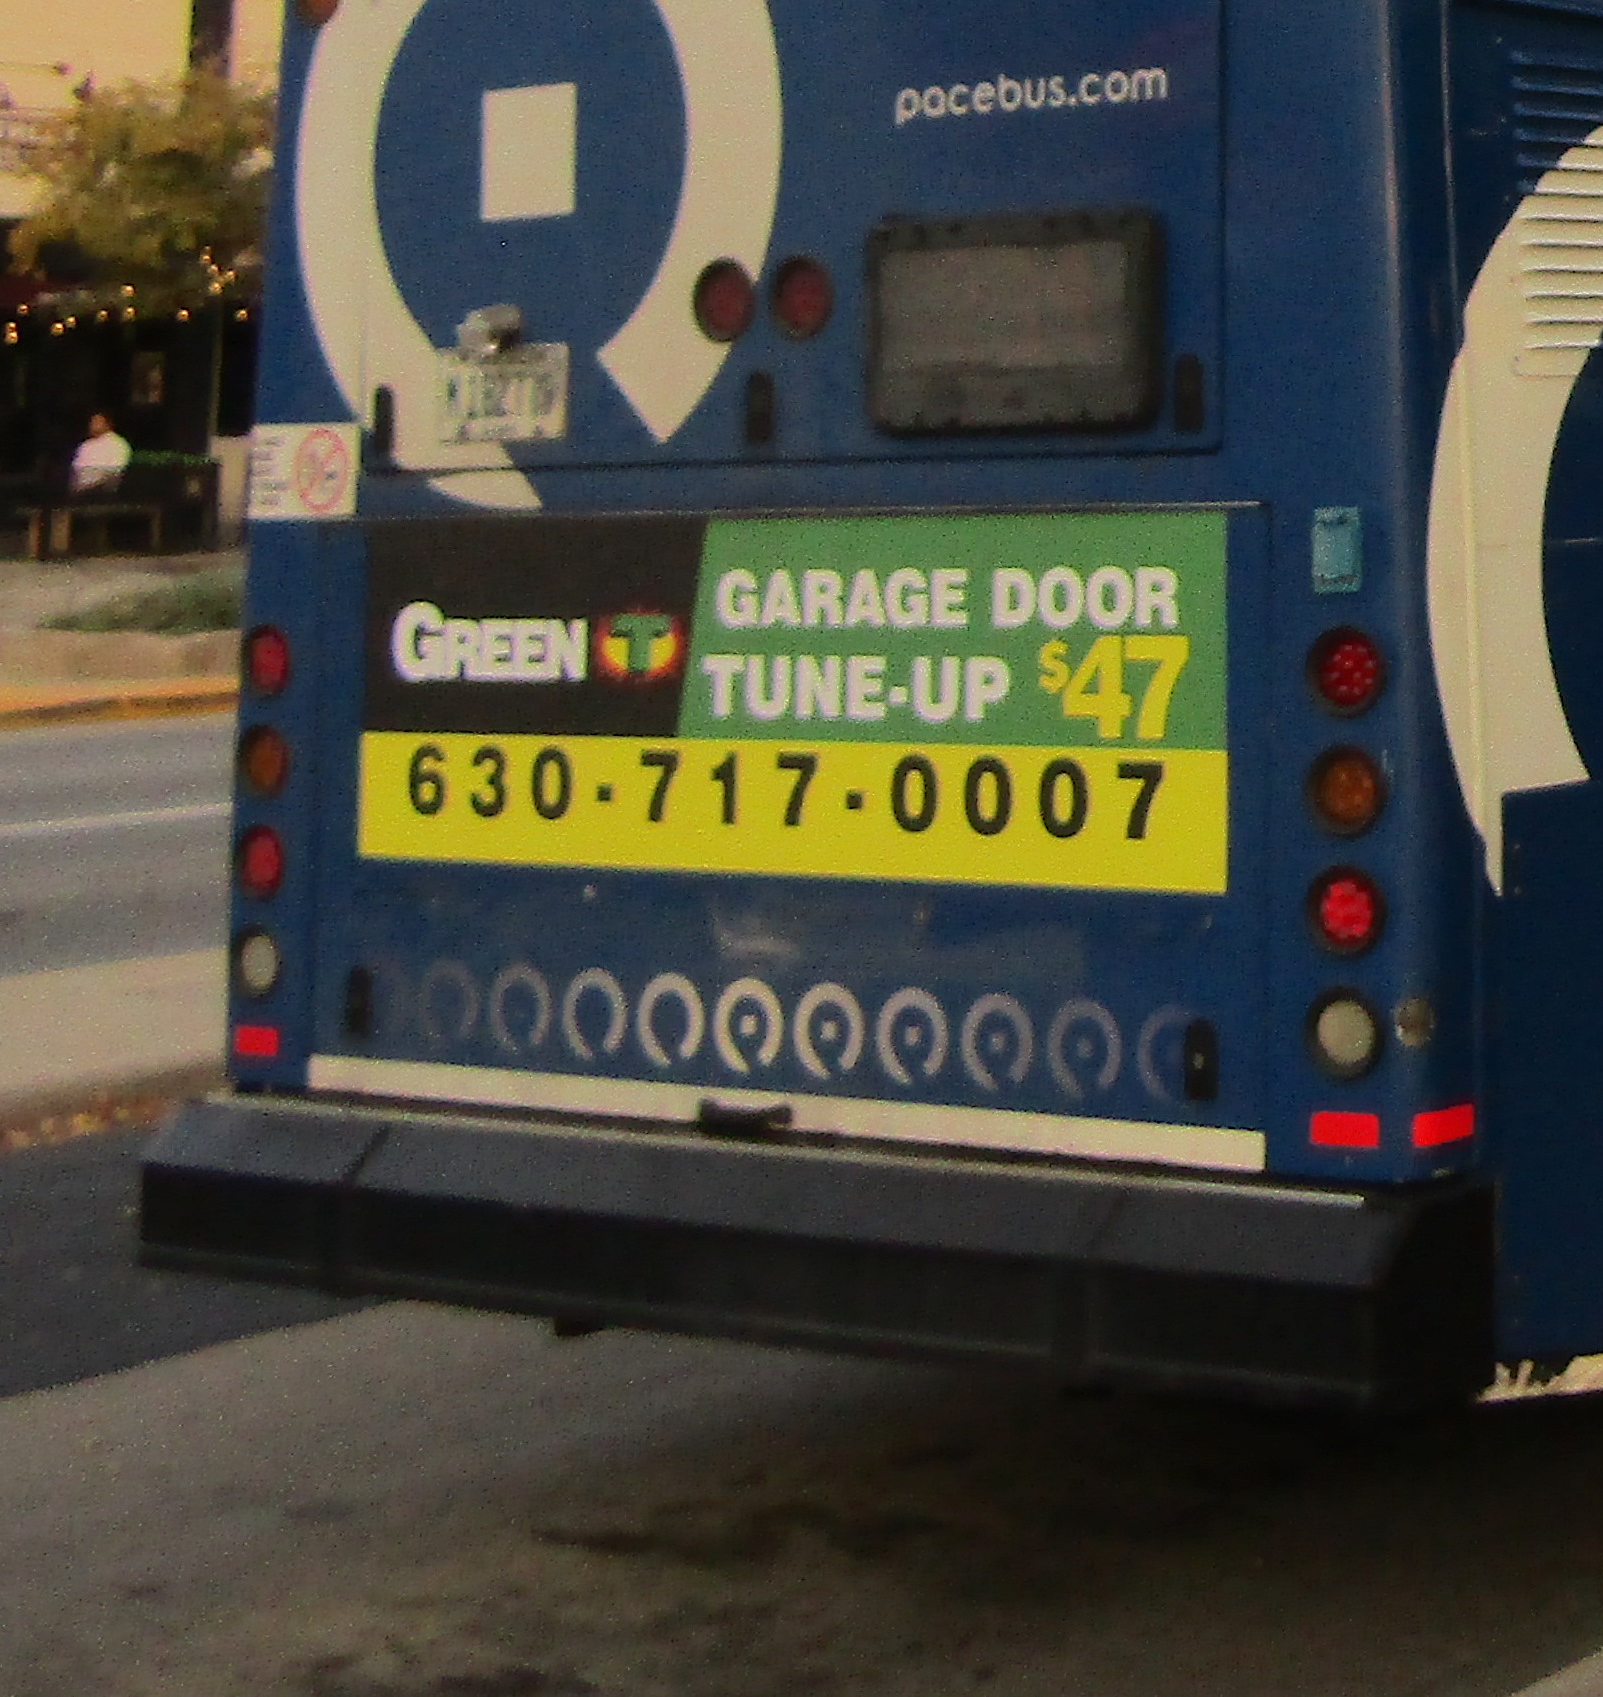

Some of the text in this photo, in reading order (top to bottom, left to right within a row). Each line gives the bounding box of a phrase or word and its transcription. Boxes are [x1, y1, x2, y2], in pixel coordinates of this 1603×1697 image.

[895, 66, 1169, 125] pacebus.com
[715, 566, 1180, 629] GARAGE DOOR
[390, 600, 591, 683] GREEN
[702, 634, 1191, 740] TUNE-UP $47
